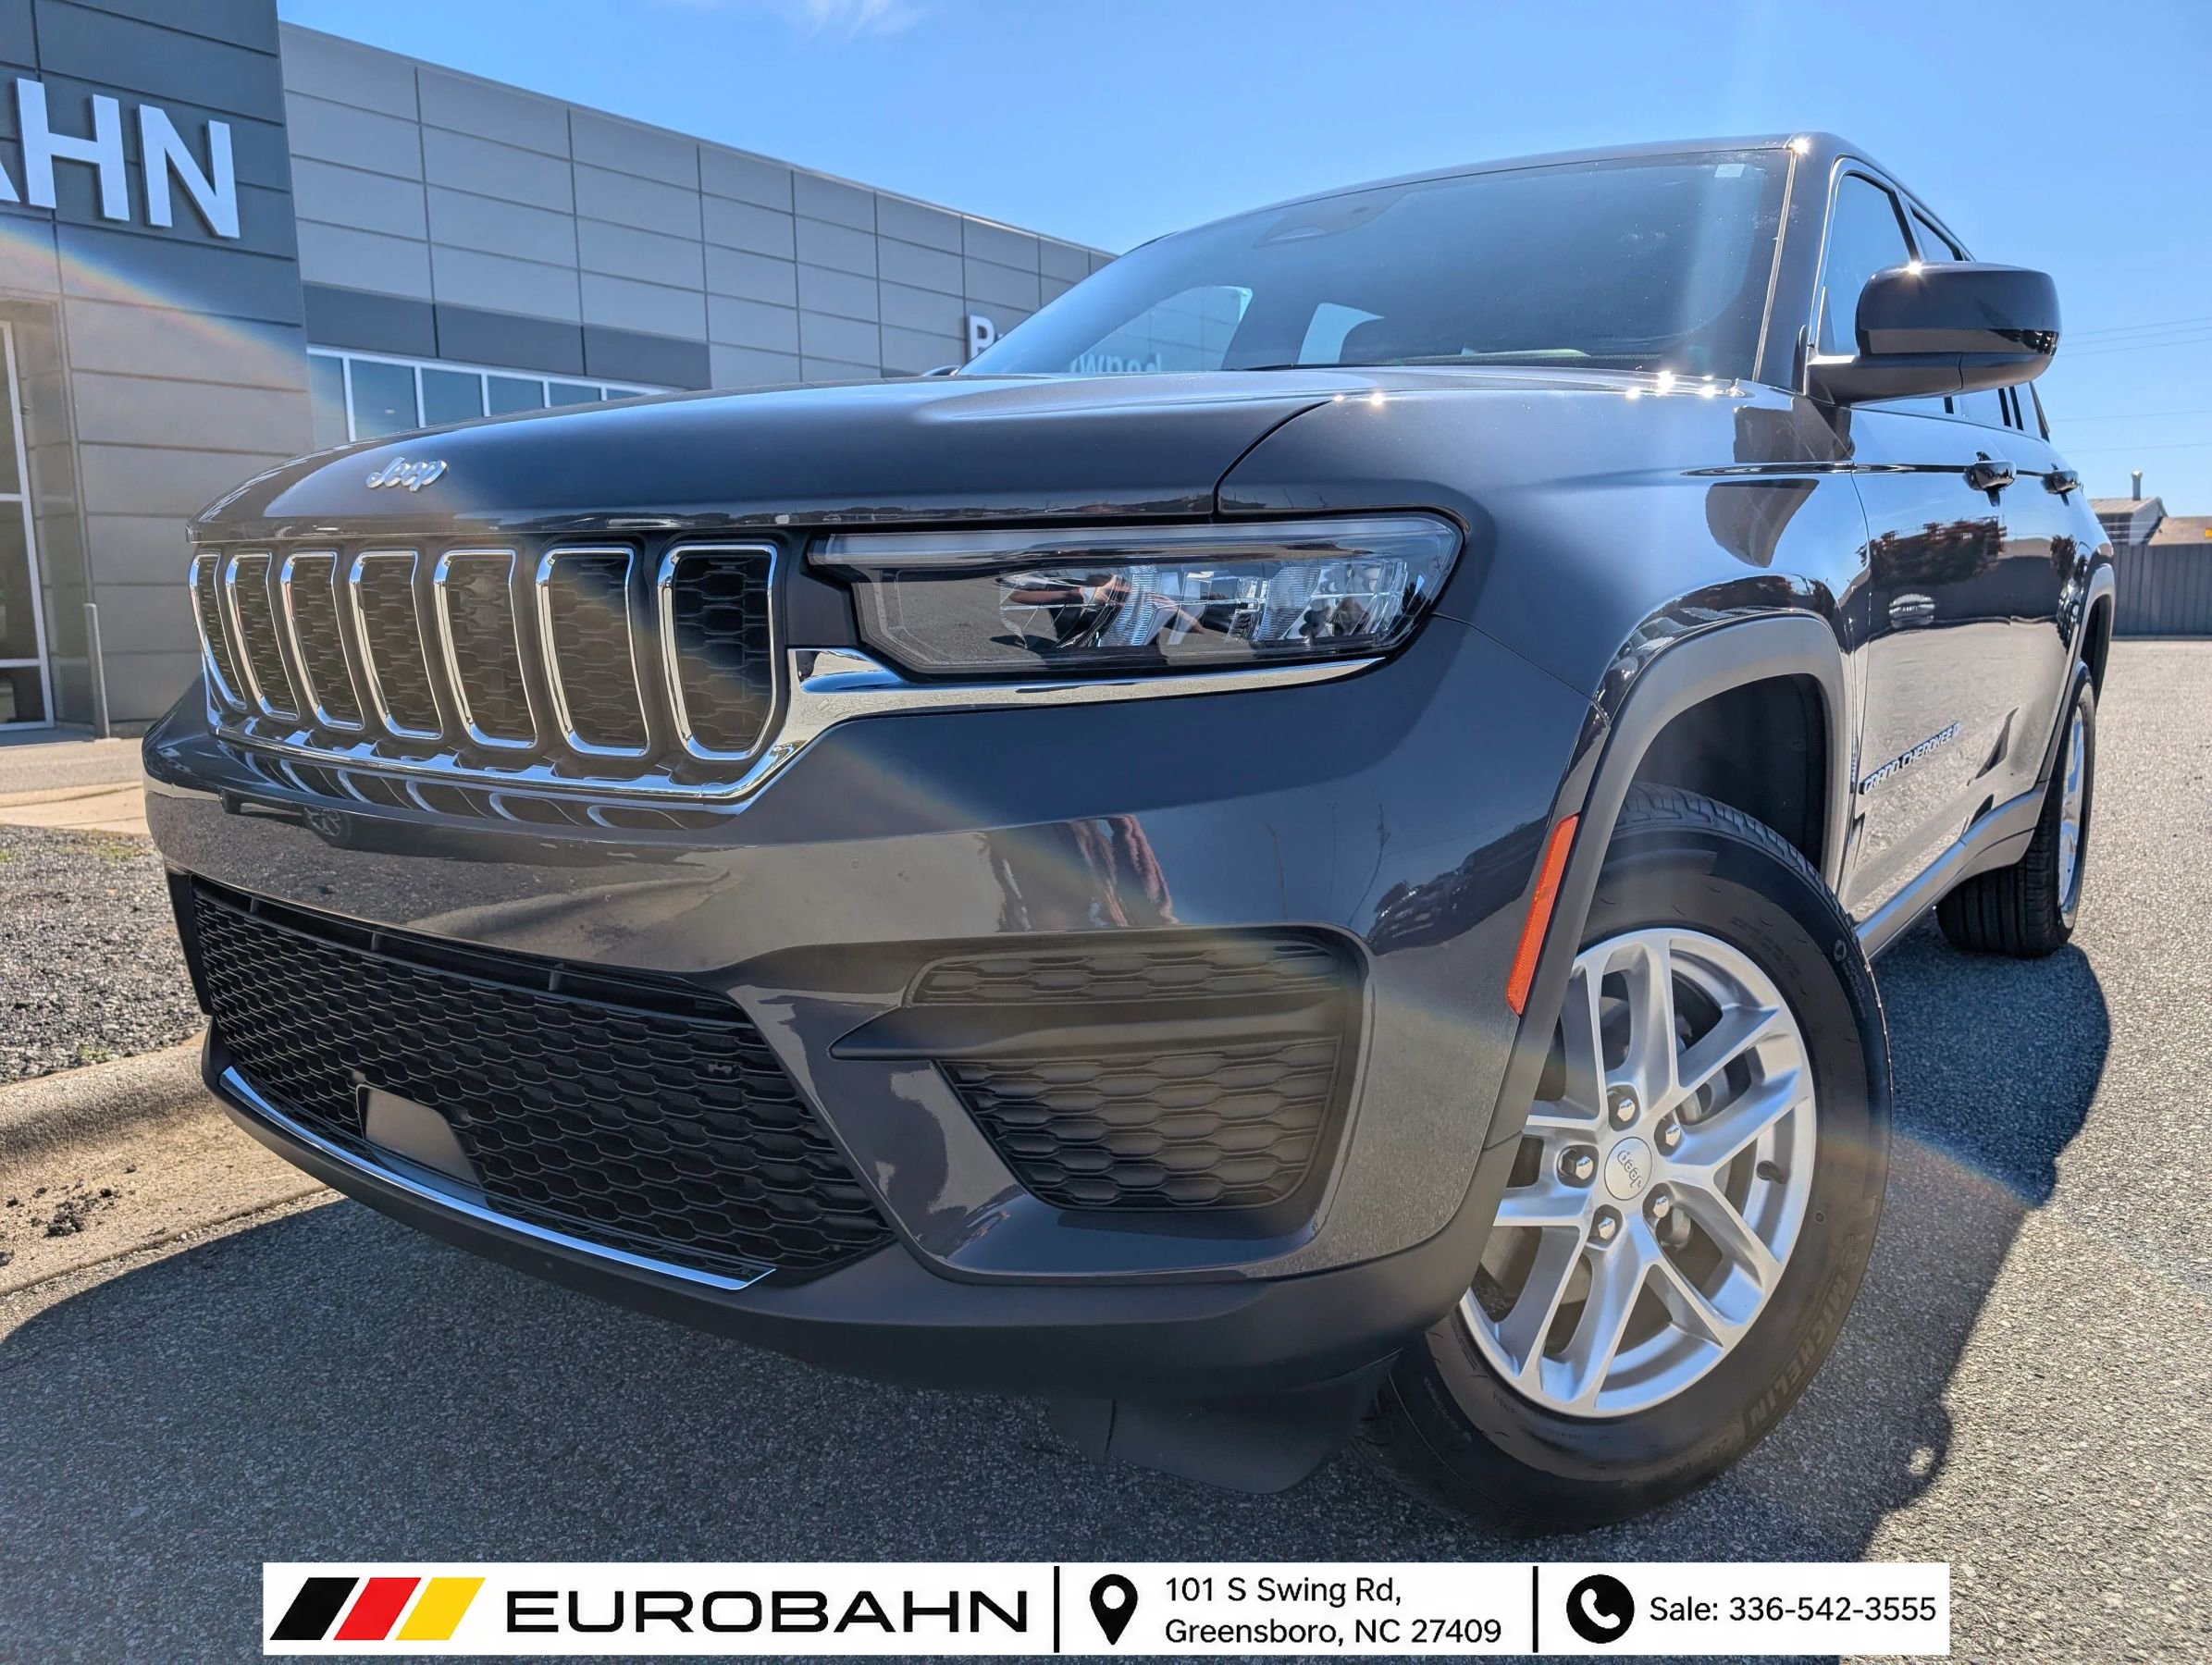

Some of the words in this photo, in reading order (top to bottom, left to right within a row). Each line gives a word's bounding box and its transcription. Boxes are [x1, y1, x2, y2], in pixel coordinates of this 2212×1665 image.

[0, 77, 241, 239] HN
[365, 456, 448, 492] Jeep
[1617, 1150, 1644, 1189] Jeep
[1748, 1273, 1849, 1431] MICHELIN
